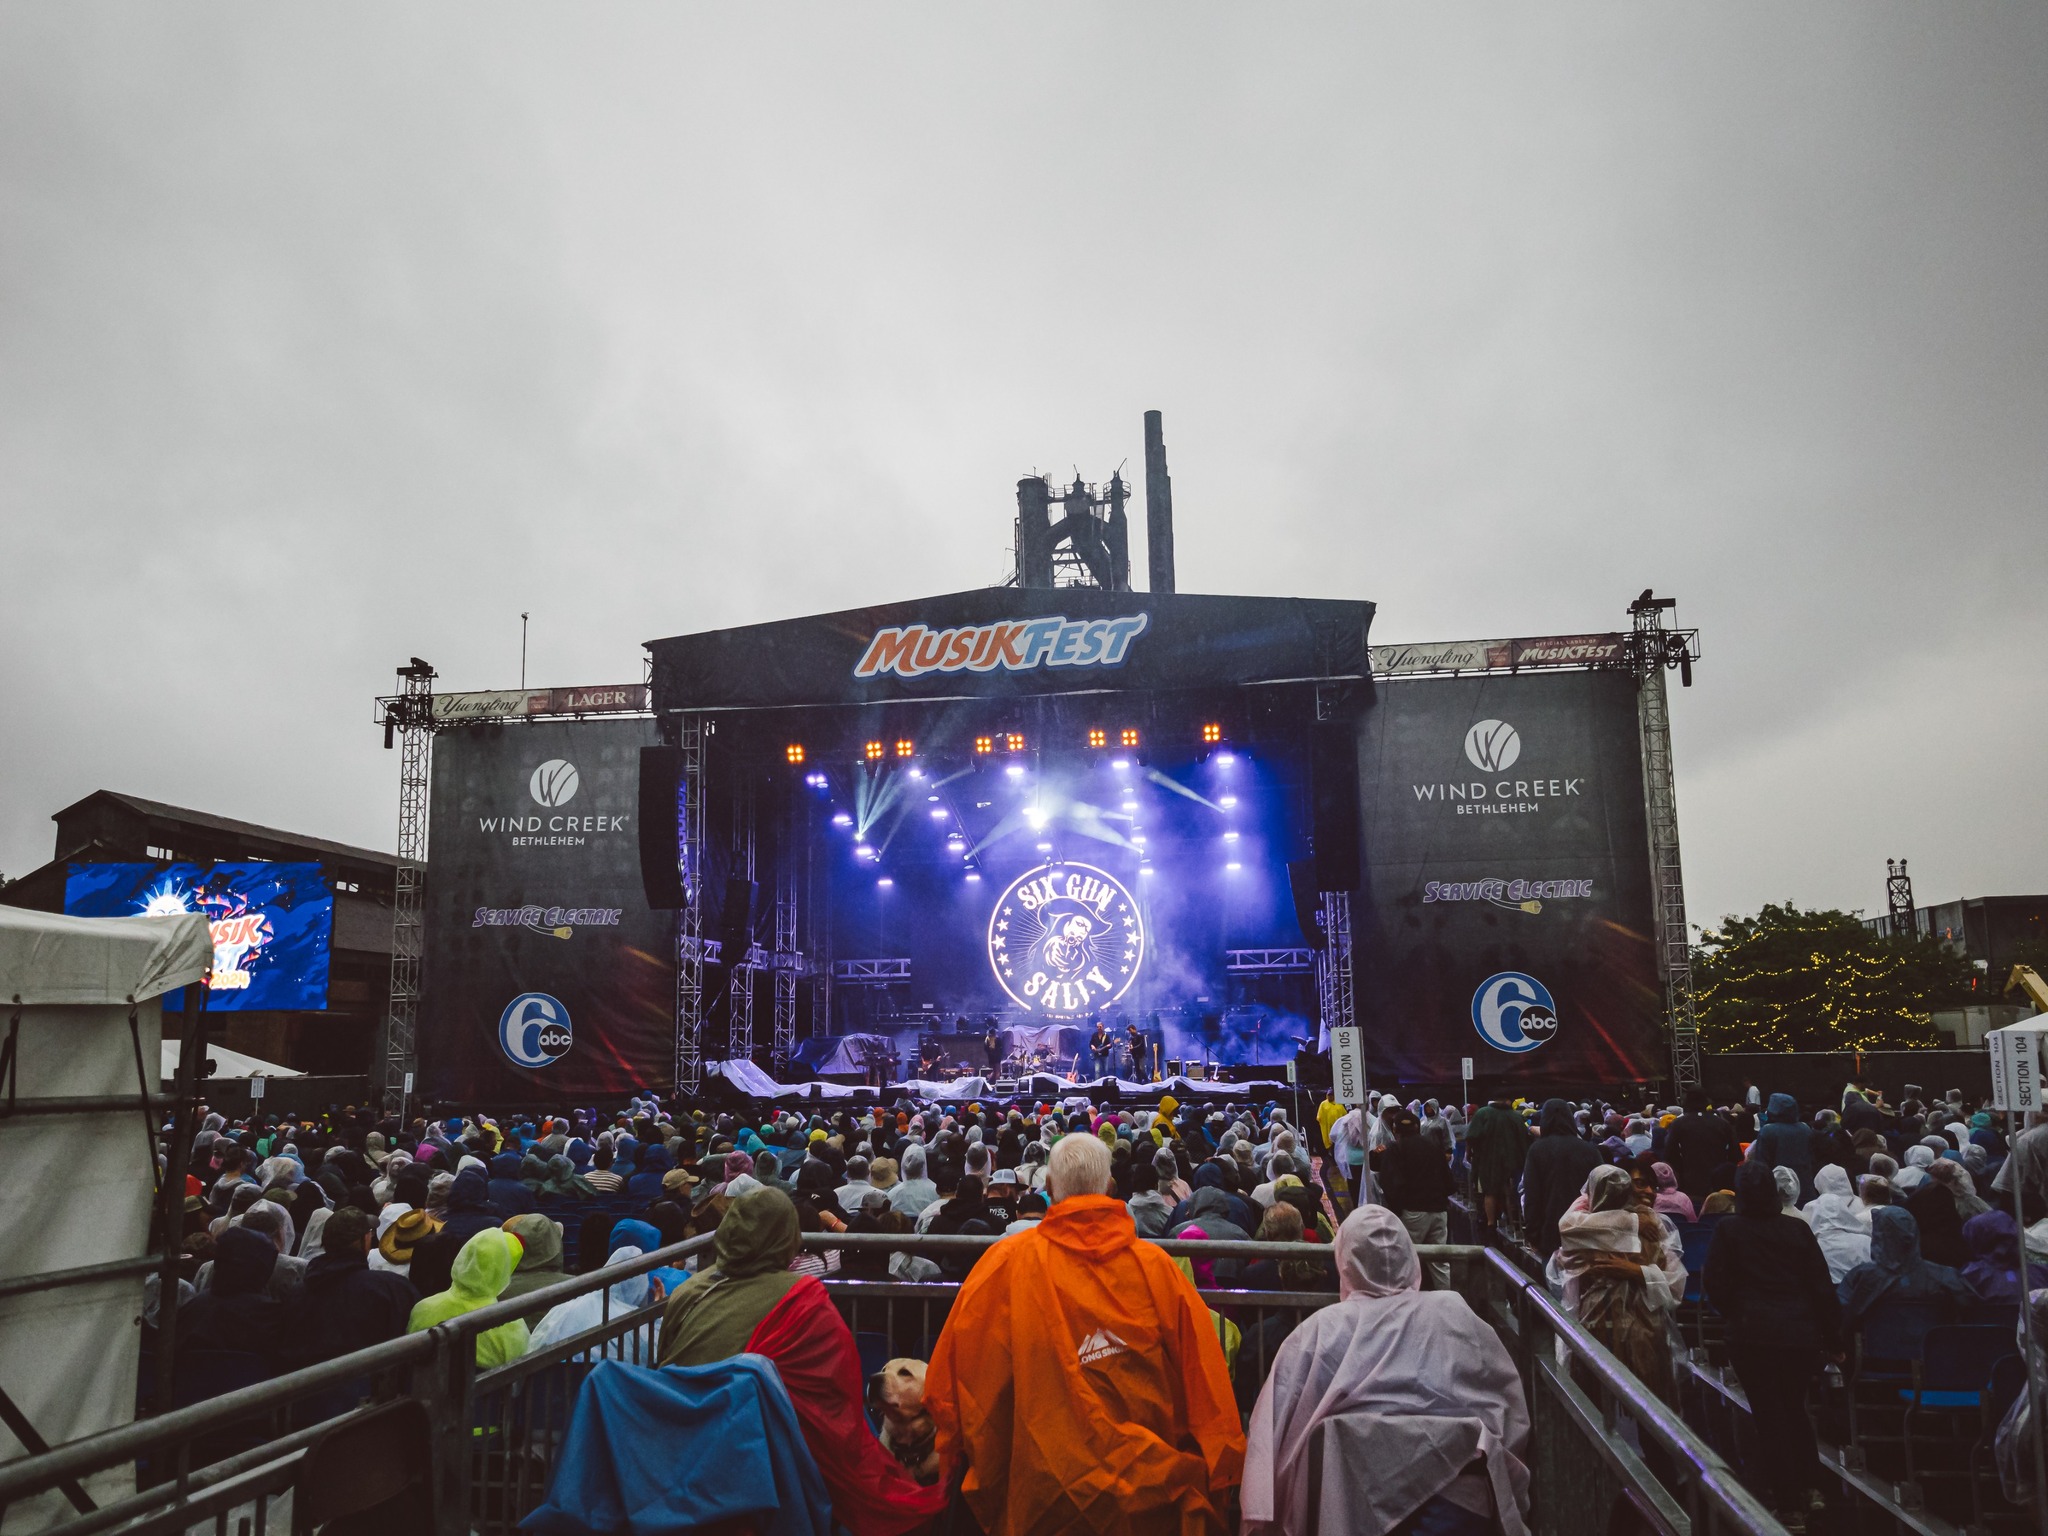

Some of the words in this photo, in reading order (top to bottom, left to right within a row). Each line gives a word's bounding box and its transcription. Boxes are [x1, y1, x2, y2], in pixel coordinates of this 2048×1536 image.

[854, 612, 1148, 678] MUSIKFEST
[1517, 644, 1618, 663] MUSIKFEST
[1378, 647, 1477, 671] Yuengling
[434, 693, 525, 715] Yuengling
[568, 691, 627, 708] LAGER
[1413, 782, 1488, 802] WIND
[1495, 778, 1580, 799] CREEK
[1456, 802, 1539, 815] BETHLEHEM
[479, 817, 542, 832] WIND
[549, 816, 624, 832] CREEK
[512, 837, 585, 846] BETHLEHEM
[1017, 874, 1060, 910] SIX
[1065, 873, 1118, 912] GUN
[1422, 880, 1503, 903] SERVICE
[1507, 878, 1593, 900] ELECTRIC
[472, 906, 541, 927] SERVICE
[544, 906, 623, 926] ELECTRIC
[208, 913, 266, 947] USIK
[209, 969, 251, 990] 2024
[1480, 976, 1537, 1048] 6
[1519, 1013, 1557, 1030] abc
[505, 997, 557, 1063] 6
[539, 1030, 572, 1046] abc
[1339, 1031, 1350, 1049] 105
[2014, 1036, 2027, 1054] 104
[1340, 1054, 1354, 1098] SECTION
[2016, 1060, 2032, 1106] SECTION
